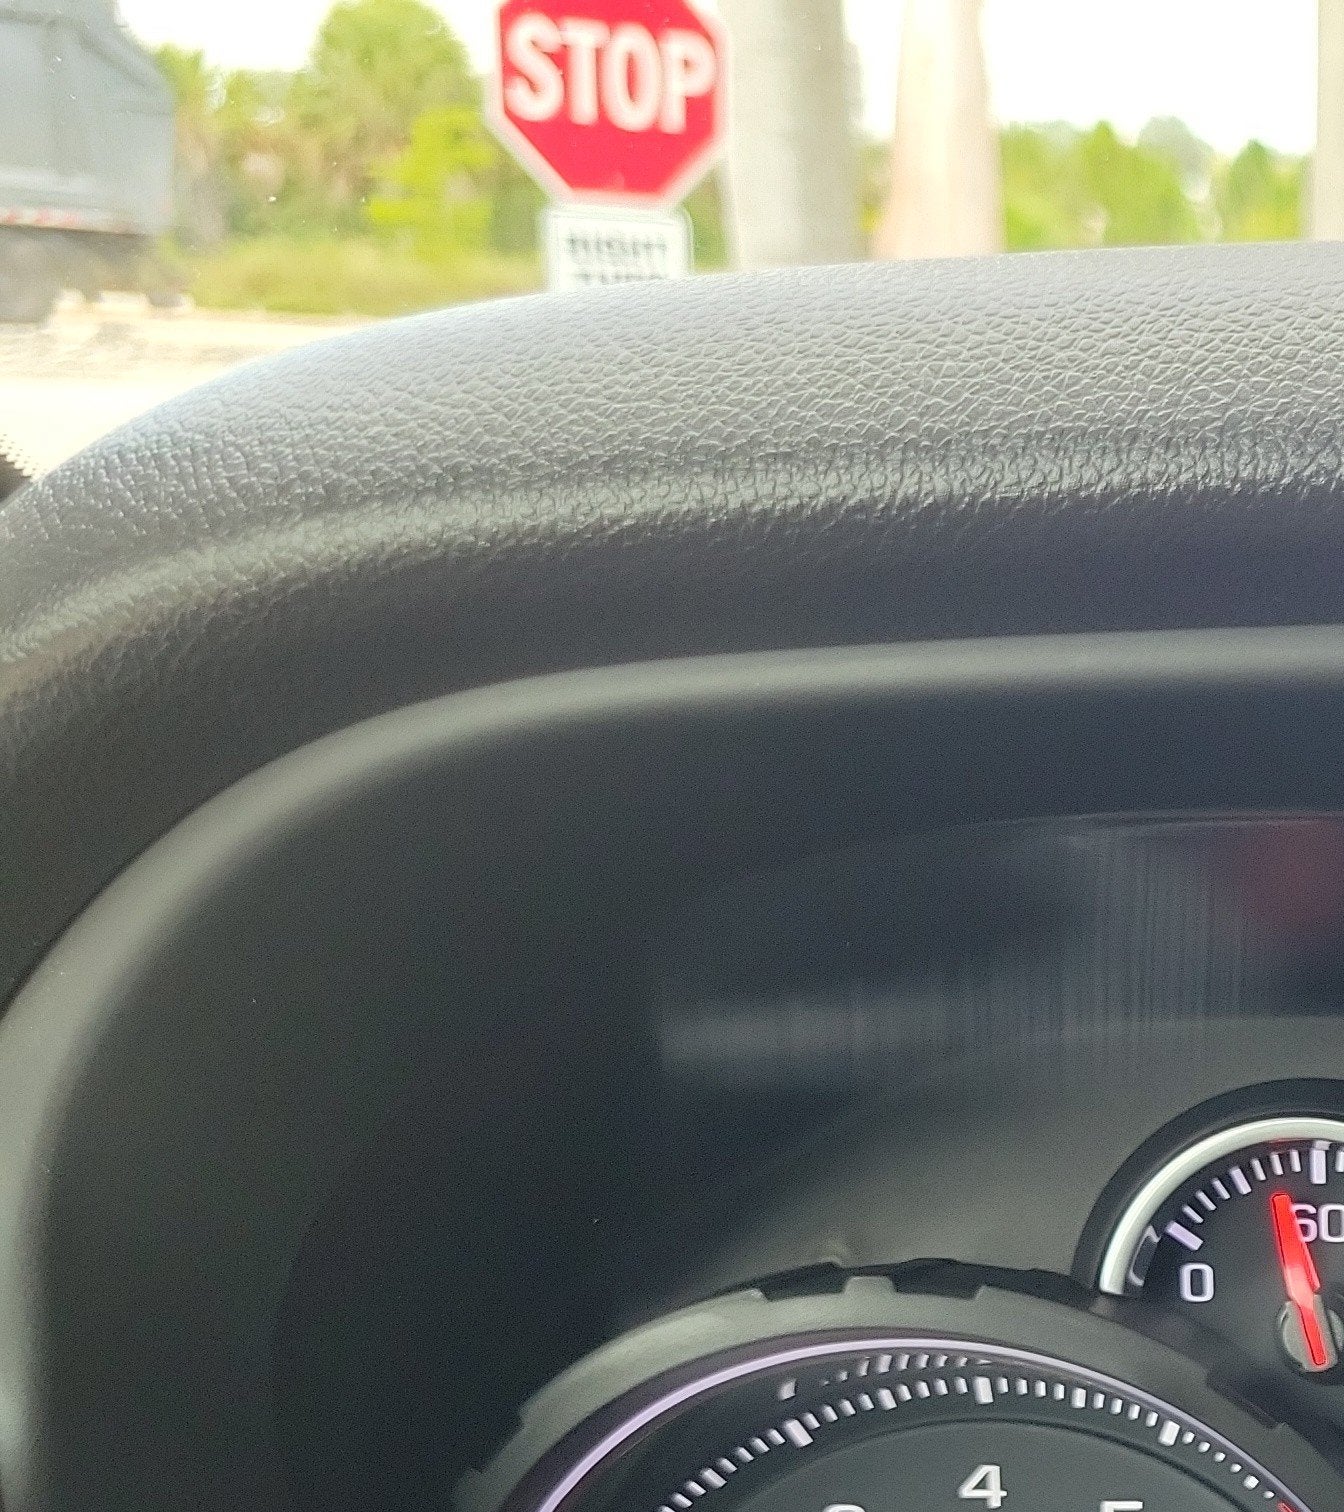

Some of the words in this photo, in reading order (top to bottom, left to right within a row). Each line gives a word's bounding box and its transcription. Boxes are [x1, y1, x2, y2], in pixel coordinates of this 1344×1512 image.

[504, 12, 716, 134] STOP
[1180, 1262, 1214, 1303] 0
[958, 1464, 1008, 1509] 4
